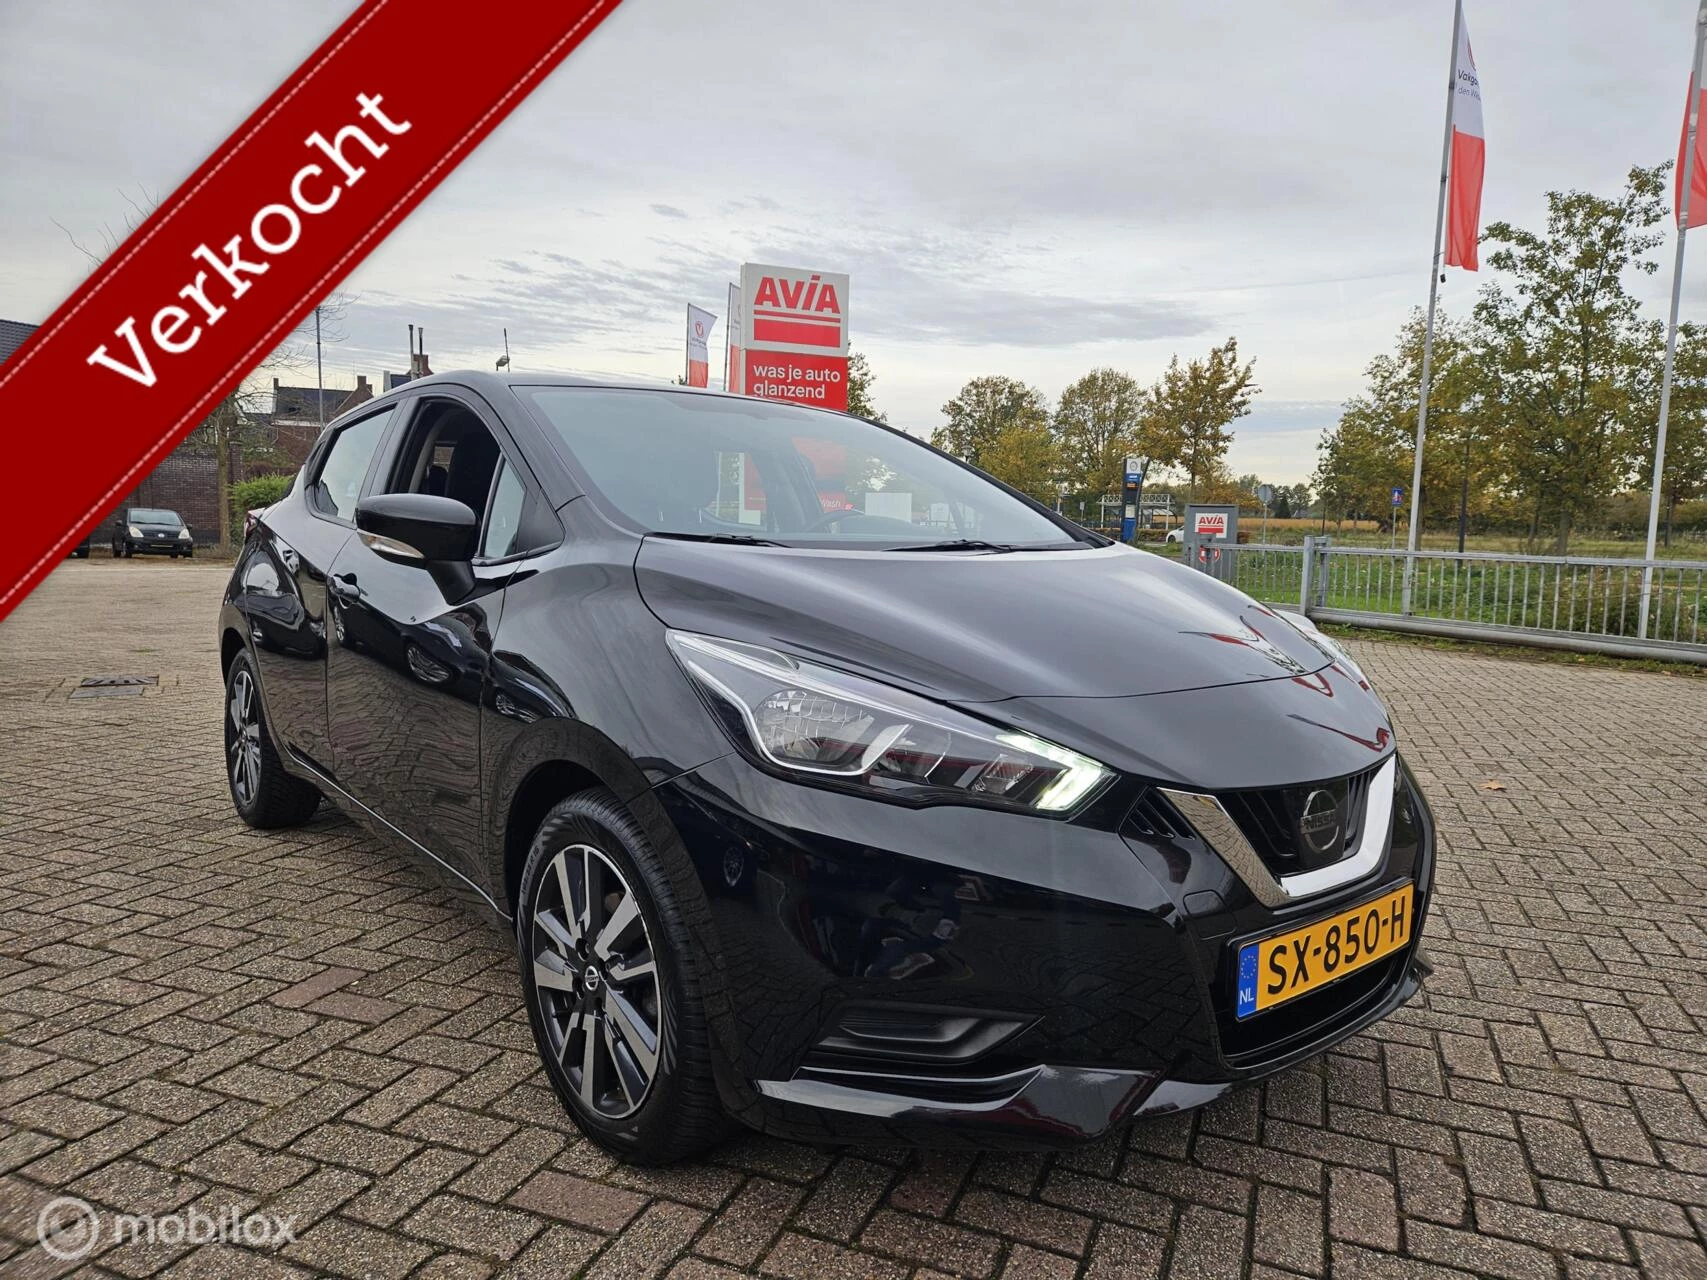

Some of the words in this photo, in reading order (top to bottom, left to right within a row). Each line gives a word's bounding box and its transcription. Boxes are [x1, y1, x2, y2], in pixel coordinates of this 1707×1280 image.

[1458, 69, 1479, 88] Vakga
[753, 364, 785, 379] was
[786, 364, 803, 384] je
[804, 368, 841, 382] auto
[753, 380, 825, 399] glanzend
[1239, 987, 1254, 1005] NL
[1267, 895, 1406, 995] SX-850-H
